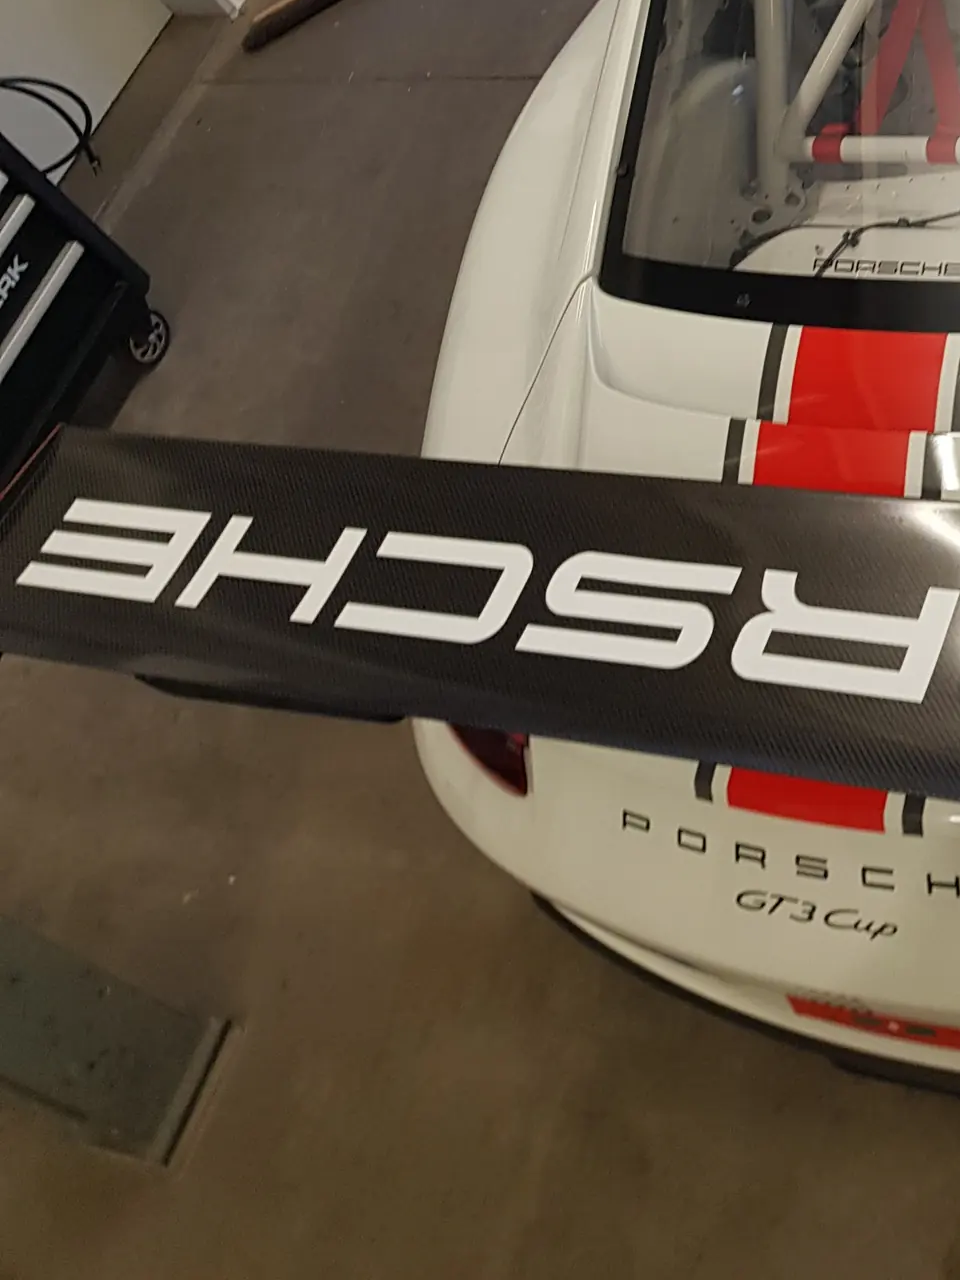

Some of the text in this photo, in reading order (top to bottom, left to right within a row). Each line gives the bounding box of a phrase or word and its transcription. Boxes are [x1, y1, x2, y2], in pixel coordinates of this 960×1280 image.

[0, 254, 29, 309] RK
[735, 888, 899, 941] GT3 Cup
